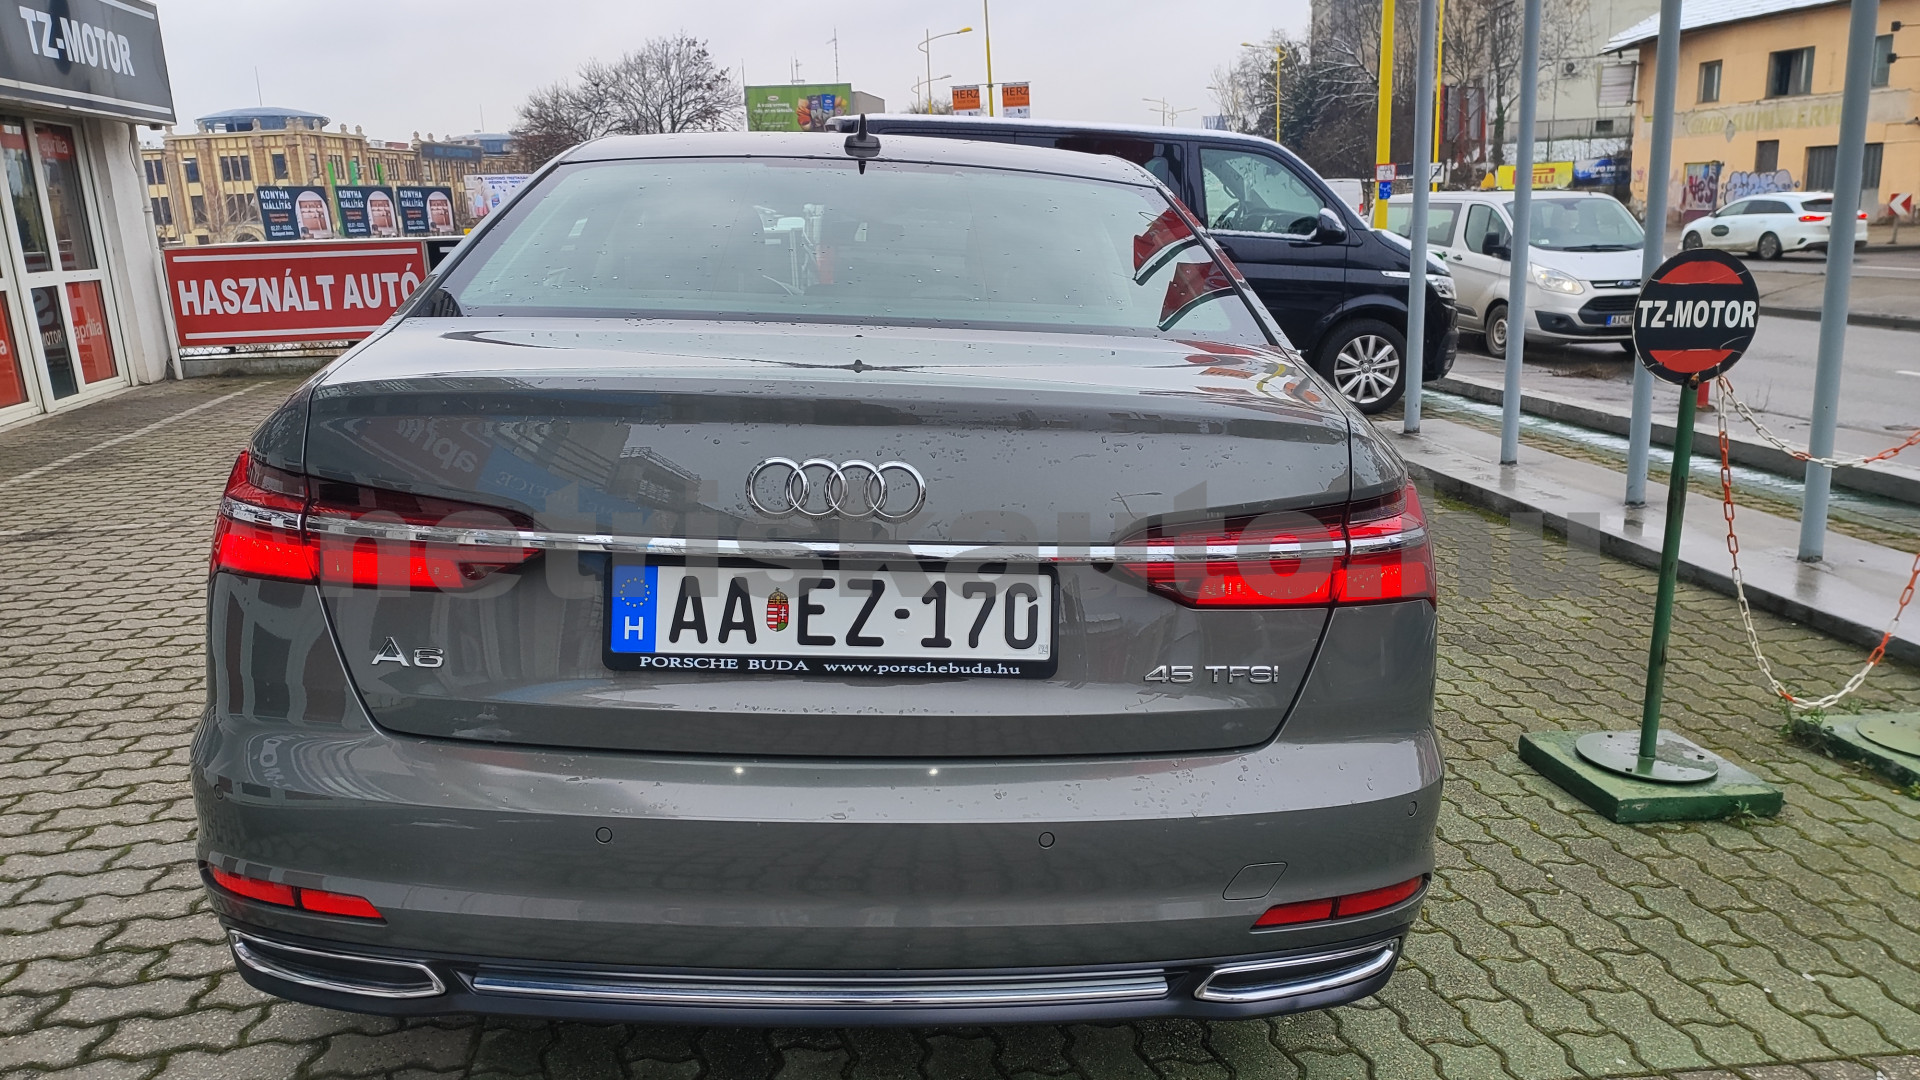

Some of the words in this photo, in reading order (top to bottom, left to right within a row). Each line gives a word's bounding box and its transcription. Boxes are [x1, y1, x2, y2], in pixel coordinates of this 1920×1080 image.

[19, 5, 135, 77] TZ-MOTOR
[953, 89, 979, 99] HERZ
[1002, 86, 1029, 96] HERZ
[260, 190, 290, 200] KONYHA
[338, 190, 362, 199] KONYHA
[400, 190, 422, 199] KONYHA
[262, 200, 292, 210] KIÁLLÍTÁS
[340, 199, 364, 208] KIÁLLÍTÁS
[401, 199, 424, 208] KIÁLLÍTÁS
[177, 268, 334, 316] HASZNÁLT
[343, 262, 421, 309] AUTÓ
[1638, 300, 1757, 329] TZ-MOTOR
[624, 615, 644, 640] H
[371, 636, 444, 668] A6
[639, 656, 739, 669] PORSCHE
[747, 659, 810, 671] BUDA
[823, 662, 1021, 676] www.porschebuda.hu
[1143, 664, 1194, 683] 45
[1204, 664, 1279, 683] TFSI
